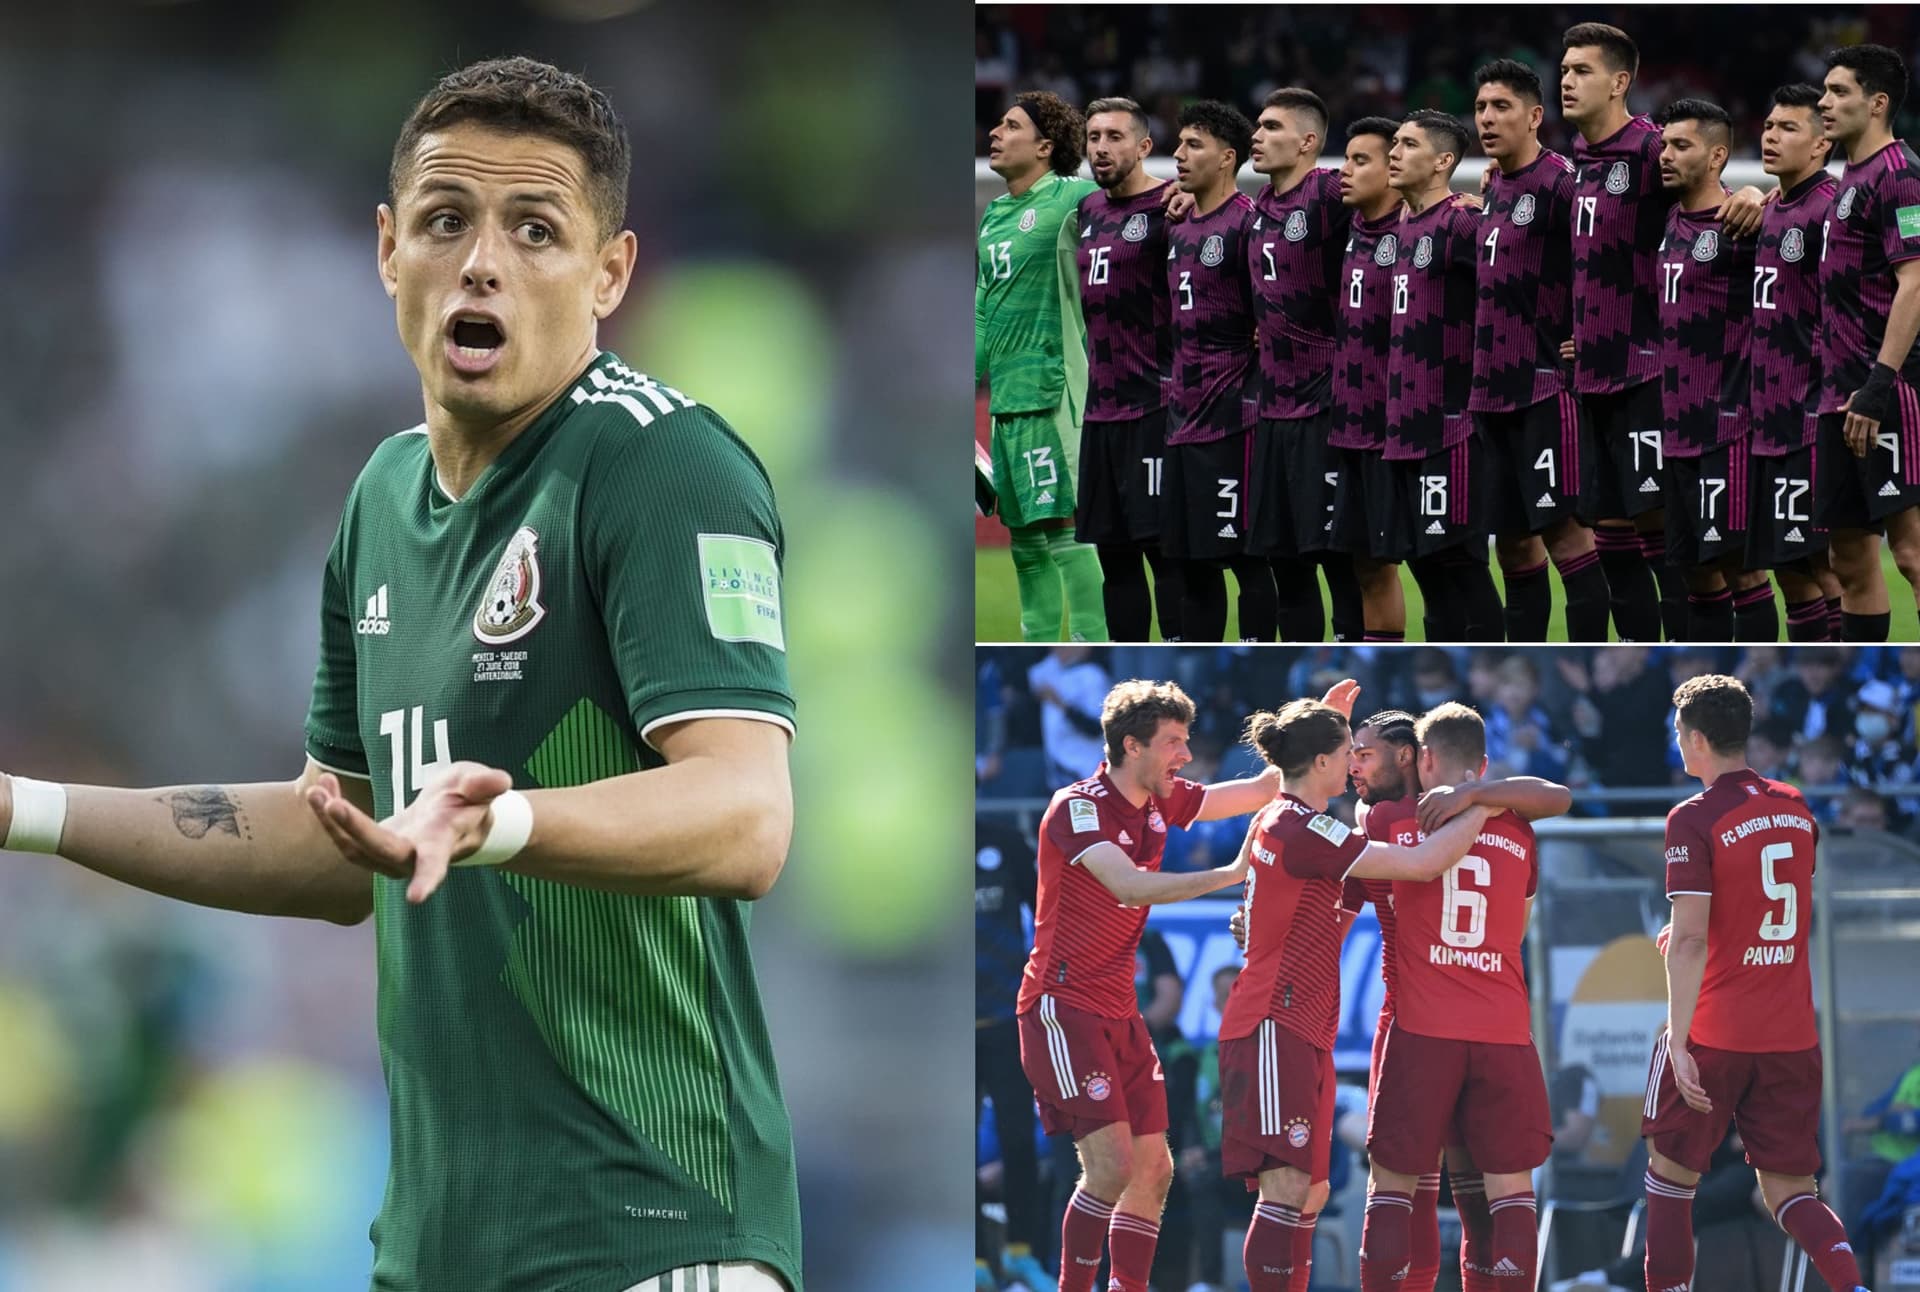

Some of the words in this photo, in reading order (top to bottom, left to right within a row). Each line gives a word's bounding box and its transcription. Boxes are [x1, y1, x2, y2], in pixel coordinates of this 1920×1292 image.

[1576, 196, 1597, 237] 19
[987, 240, 1013, 280] 13
[1088, 246, 1111, 286] 16
[1262, 242, 1277, 280] 5
[1485, 227, 1499, 266] 4
[1178, 271, 1193, 310] 3
[1350, 268, 1363, 308] 8
[1393, 274, 1408, 314] 18
[1663, 262, 1684, 303] 17
[1753, 266, 1778, 309] 22
[1023, 446, 1058, 488] 13
[1533, 448, 1556, 488] 4
[1628, 430, 1663, 472] 19
[1875, 432, 1900, 474] 9
[1216, 479, 1239, 518] 3
[1419, 475, 1447, 515] 18
[1699, 478, 1726, 519] 17
[1774, 477, 1809, 521] 22
[709, 567, 773, 586] LIVING
[756, 604, 776, 620] FIFA
[477, 662, 485, 672] 27
[486, 662, 502, 671] JUNE
[503, 661, 520, 670] 2018
[500, 651, 528, 661] SWEDEN
[380, 705, 452, 818] 14
[1396, 832, 1413, 845] FC
[1720, 830, 1737, 847] FC
[1735, 815, 1772, 839] BAYERN
[1440, 854, 1491, 948] 6
[1758, 841, 1797, 941] 5
[1430, 944, 1502, 972] KIMMICH
[631, 1207, 688, 1220] CLIMACHILL
